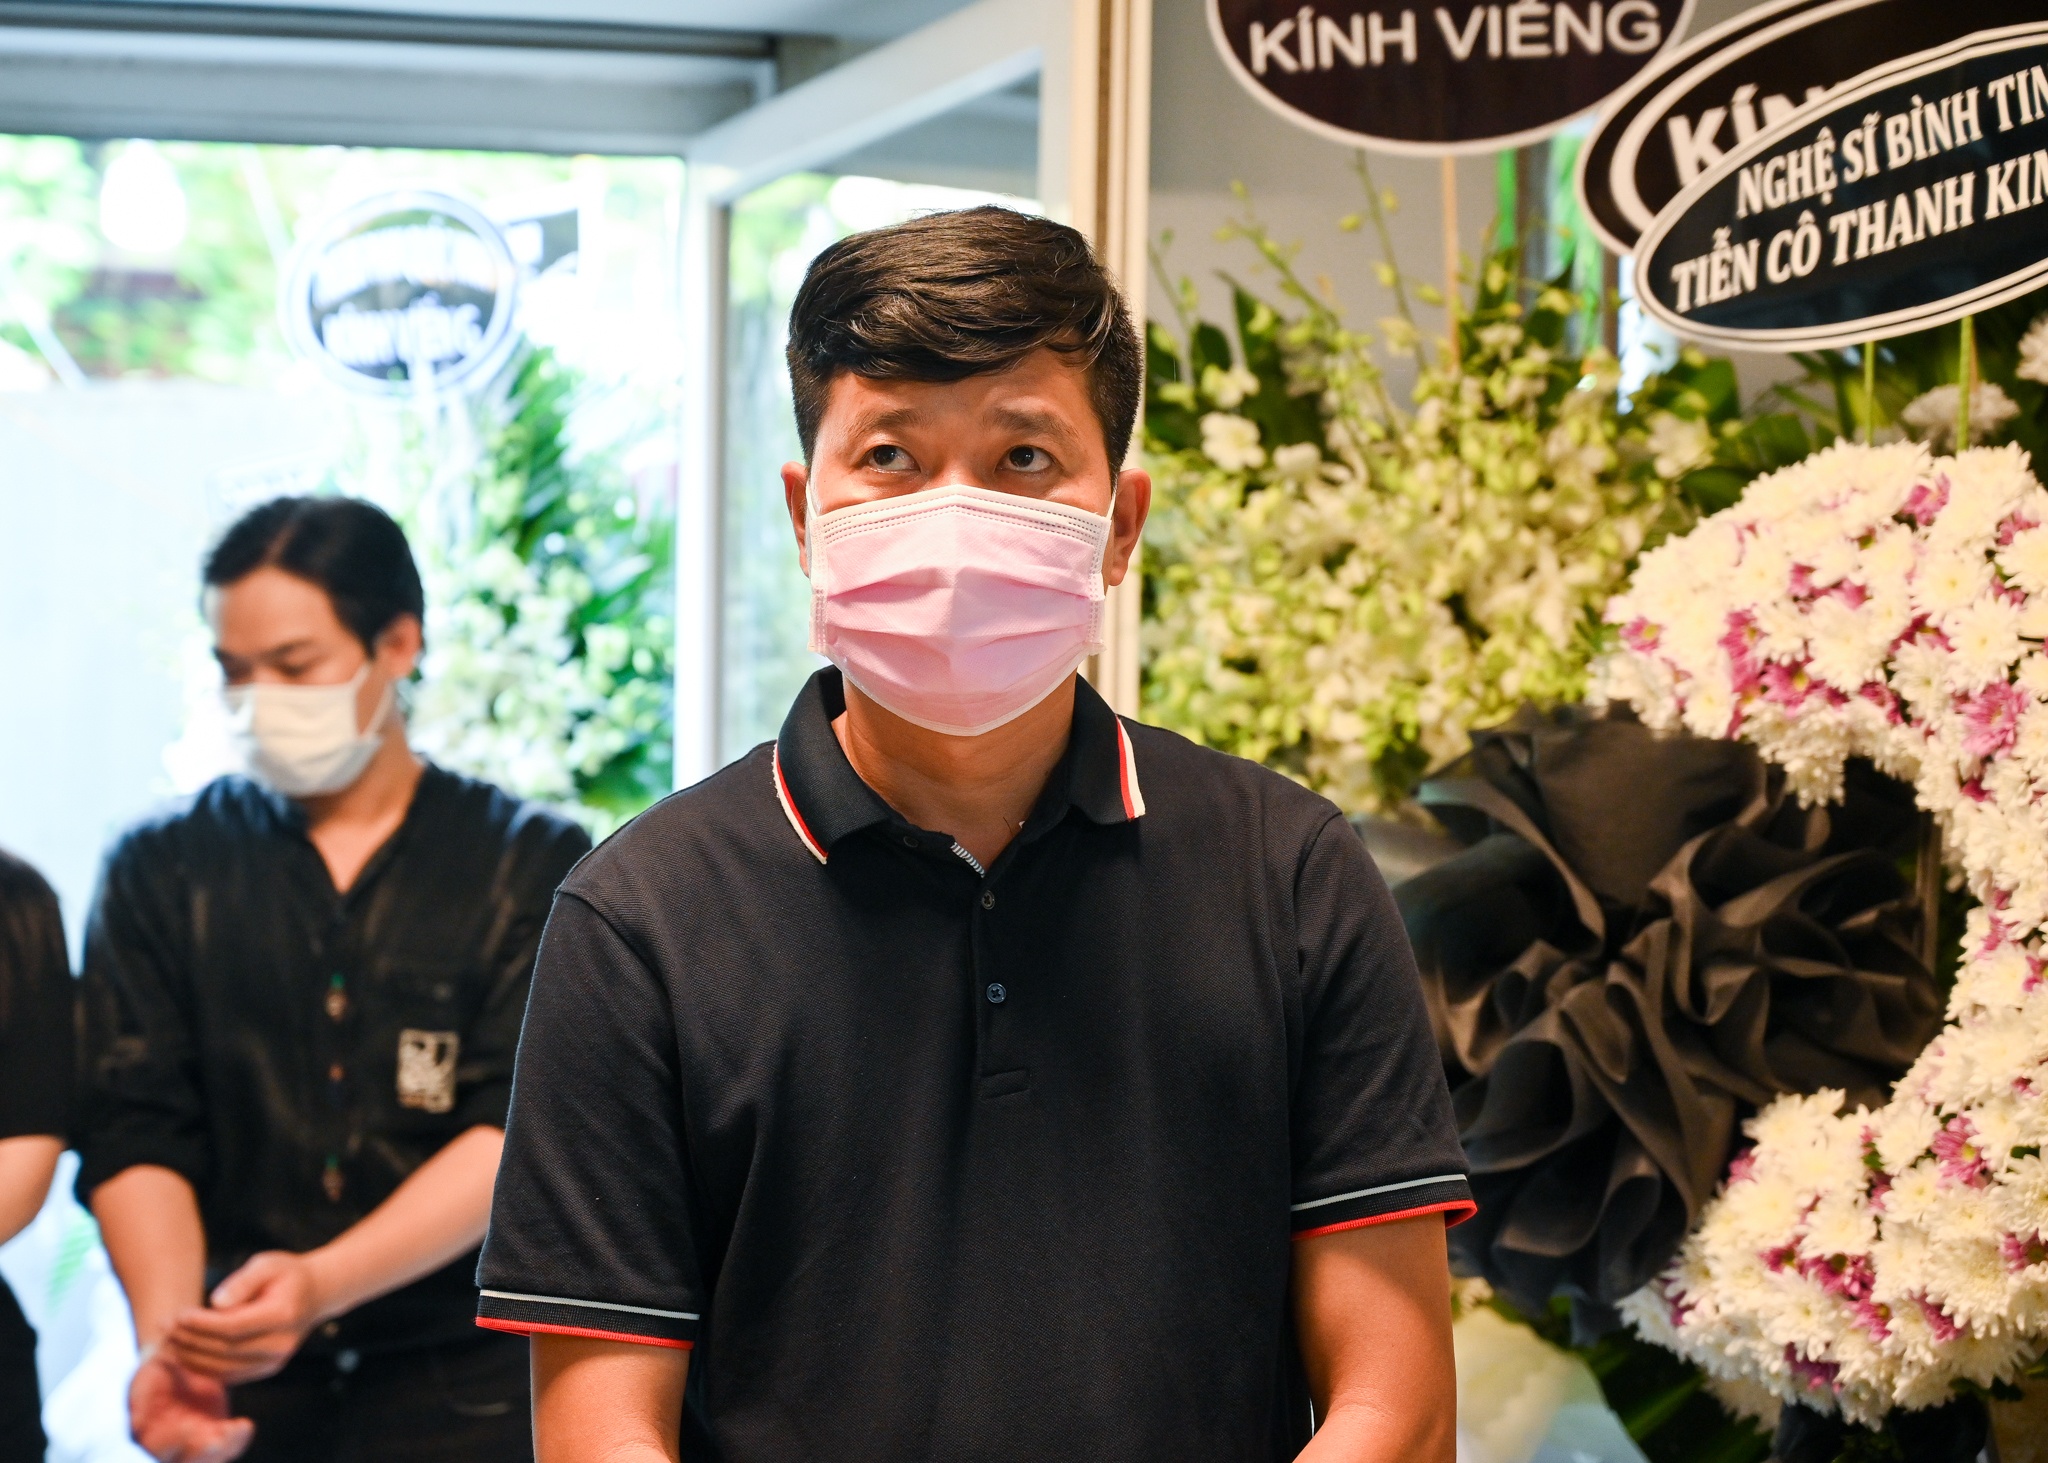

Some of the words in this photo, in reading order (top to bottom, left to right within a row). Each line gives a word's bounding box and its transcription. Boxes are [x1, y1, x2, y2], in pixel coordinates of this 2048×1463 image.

[1249, 6, 1417, 75] KÍNH
[1736, 126, 1838, 219] NGHỆ
[1842, 110, 1882, 185] SĨ
[1884, 86, 1984, 170] BÌNH
[1670, 225, 1761, 314] TIỄN
[1766, 209, 1822, 284] CÔ
[1828, 171, 1976, 267] THANH
